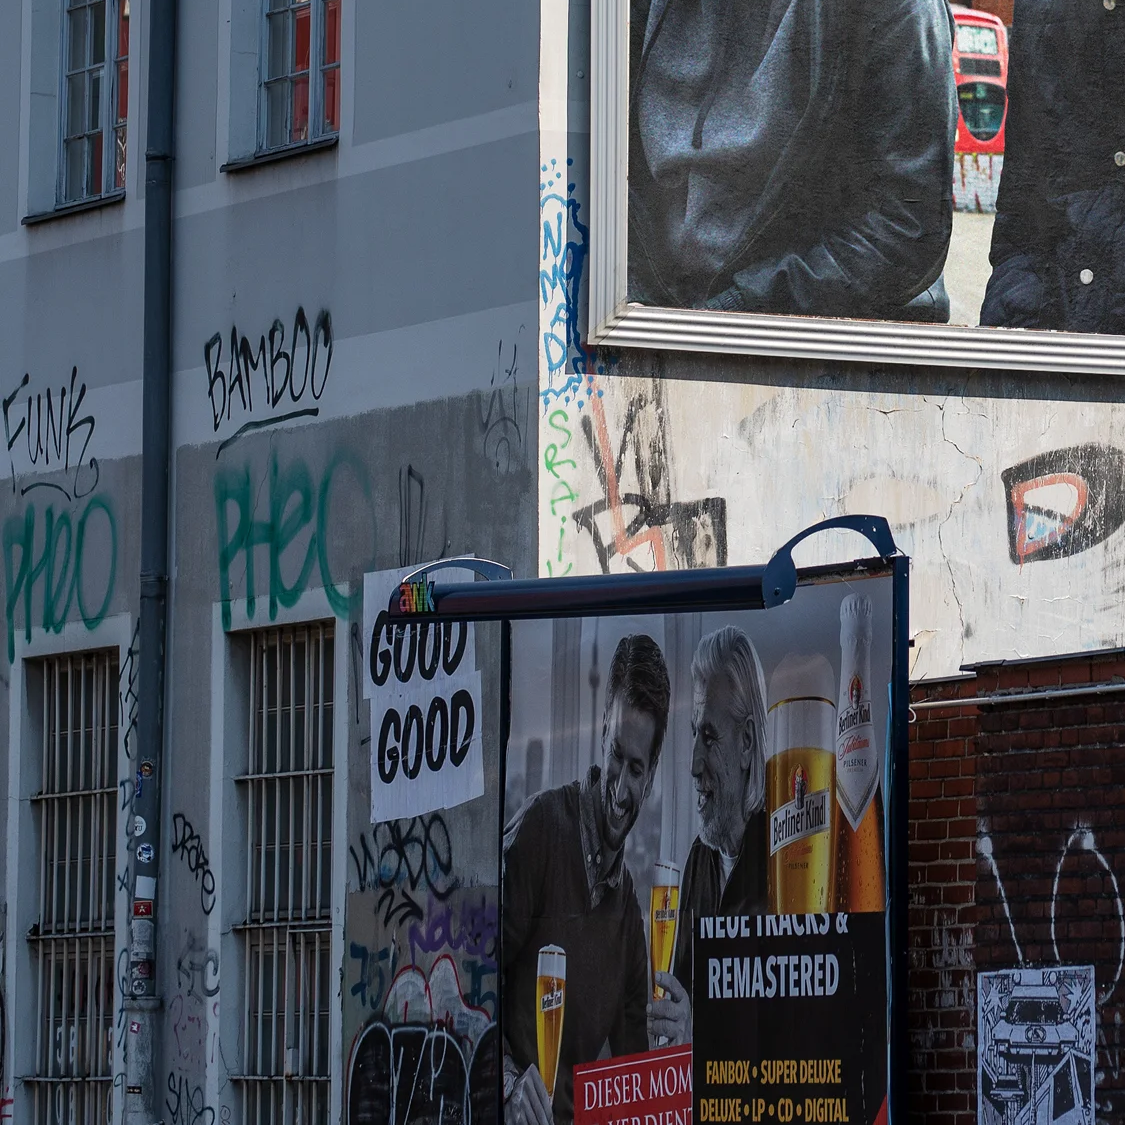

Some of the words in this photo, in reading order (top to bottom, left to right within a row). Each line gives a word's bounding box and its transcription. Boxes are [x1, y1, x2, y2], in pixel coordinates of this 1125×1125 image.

[204, 306, 334, 432] BAMBOO
[2, 365, 99, 499] FUNK
[369, 609, 468, 687] GOOD
[377, 689, 475, 785] GOOD
[773, 809, 804, 846] Berliner
[805, 795, 826, 830] Kindl
[708, 953, 840, 999] REMASTERED
[583, 1073, 645, 1111] DIESER
[706, 1060, 750, 1085] FANBOX
[760, 1060, 798, 1085] SUPER
[800, 1059, 842, 1084] DELUXE
[700, 1098, 742, 1123] DELUXE
[752, 1098, 765, 1123] LP
[777, 1098, 793, 1123] CD
[804, 1098, 849, 1123] DIGITAL
